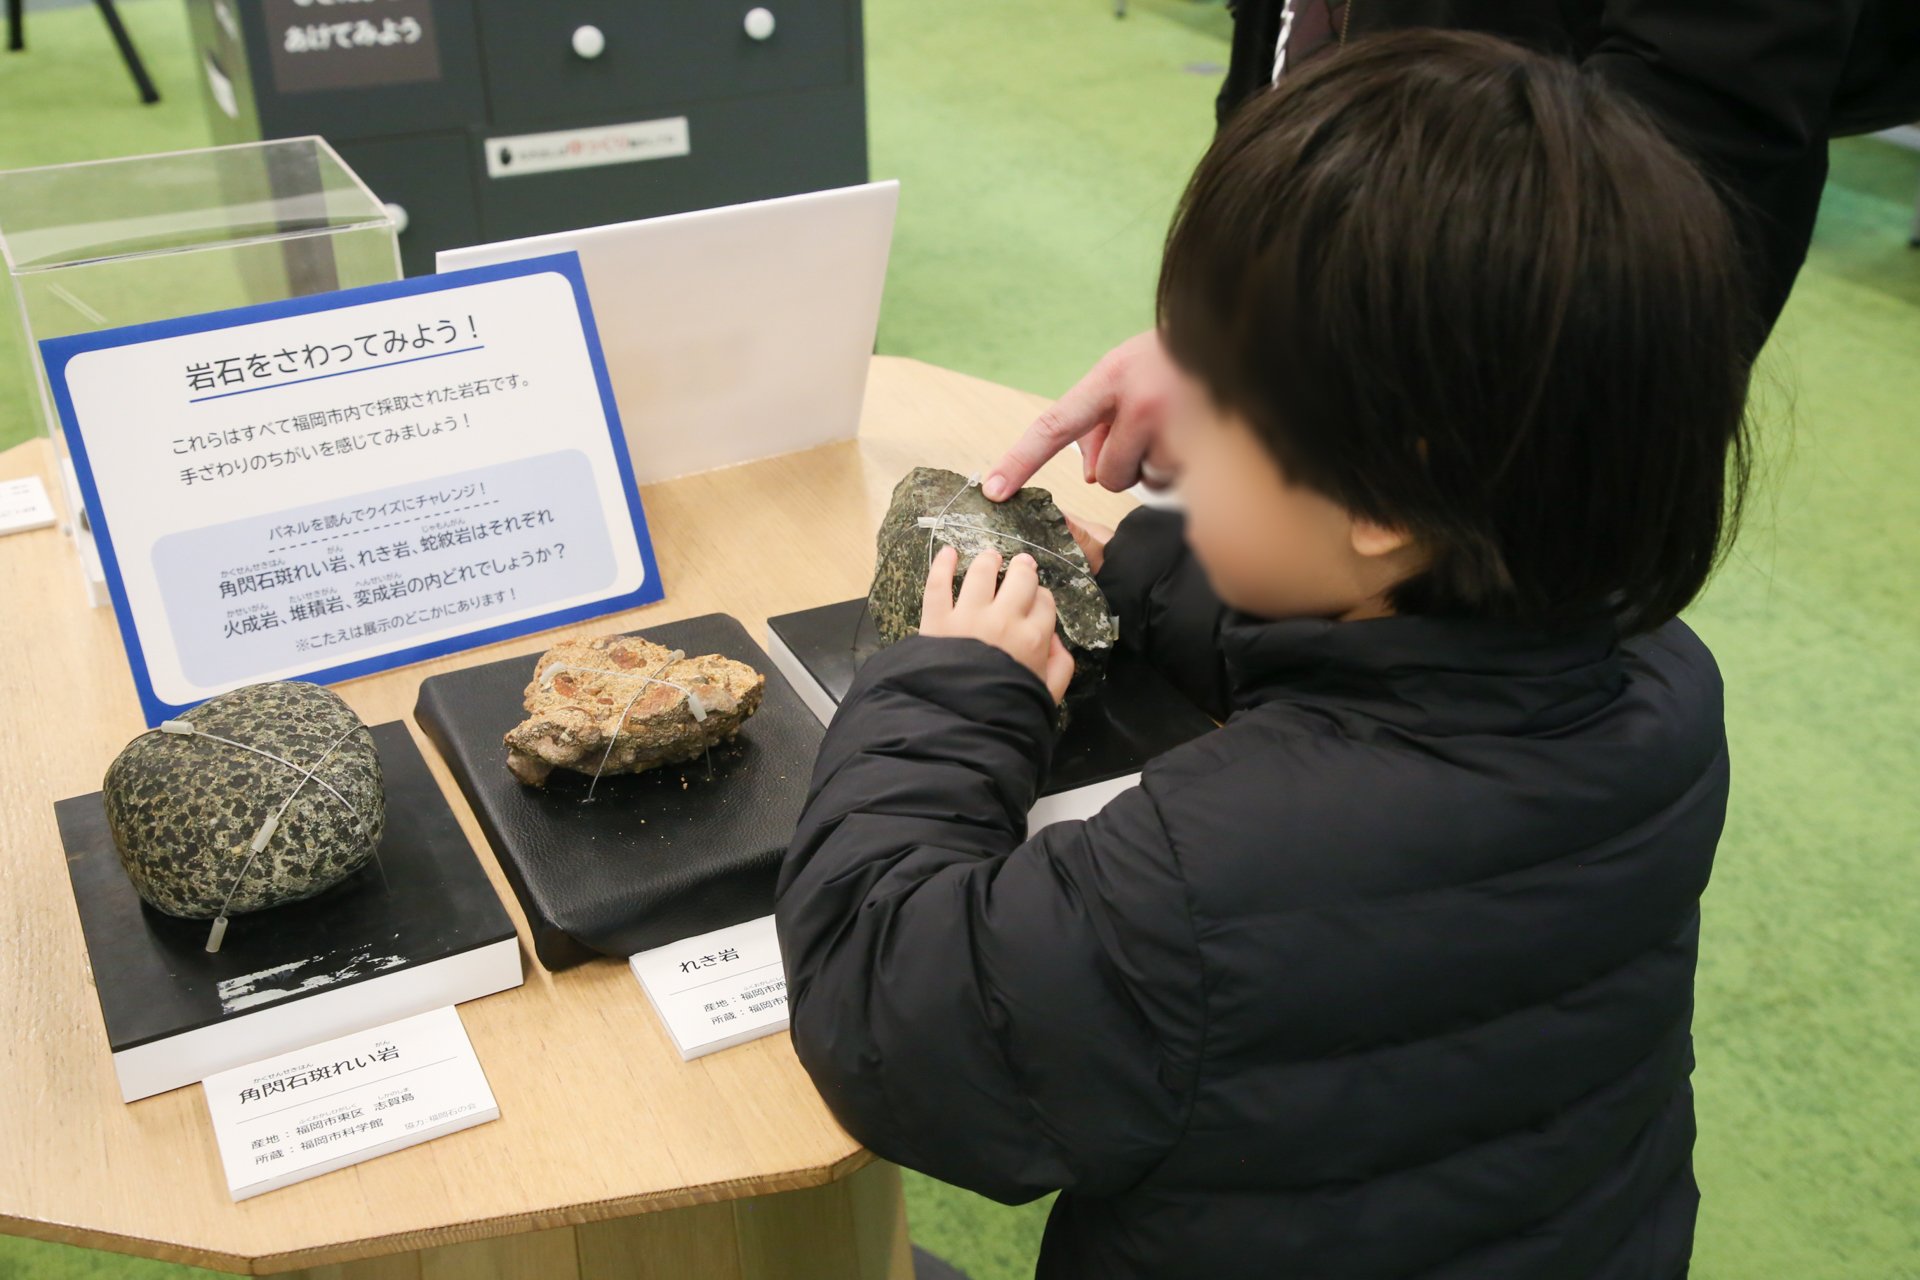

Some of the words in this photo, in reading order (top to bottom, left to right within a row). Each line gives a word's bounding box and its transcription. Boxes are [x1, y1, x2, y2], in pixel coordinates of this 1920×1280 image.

[284, 16, 422, 53] あけてみよう
[185, 314, 479, 391] 岩石をさわってみよう！
[172, 373, 530, 455] これらはすべて福岡市内で採取された岩石です。
[179, 412, 471, 486] 手ざわりのちがいを感じてみましょう！
[269, 482, 487, 541] パネルを読んでクイズにチャレンジ！
[295, 587, 517, 652] ※こたえは展示のどこかにあります！
[678, 947, 740, 973] れき岩
[238, 1045, 400, 1105] 角閃石斑れい岩
[373, 1092, 415, 1112] 志賀島
